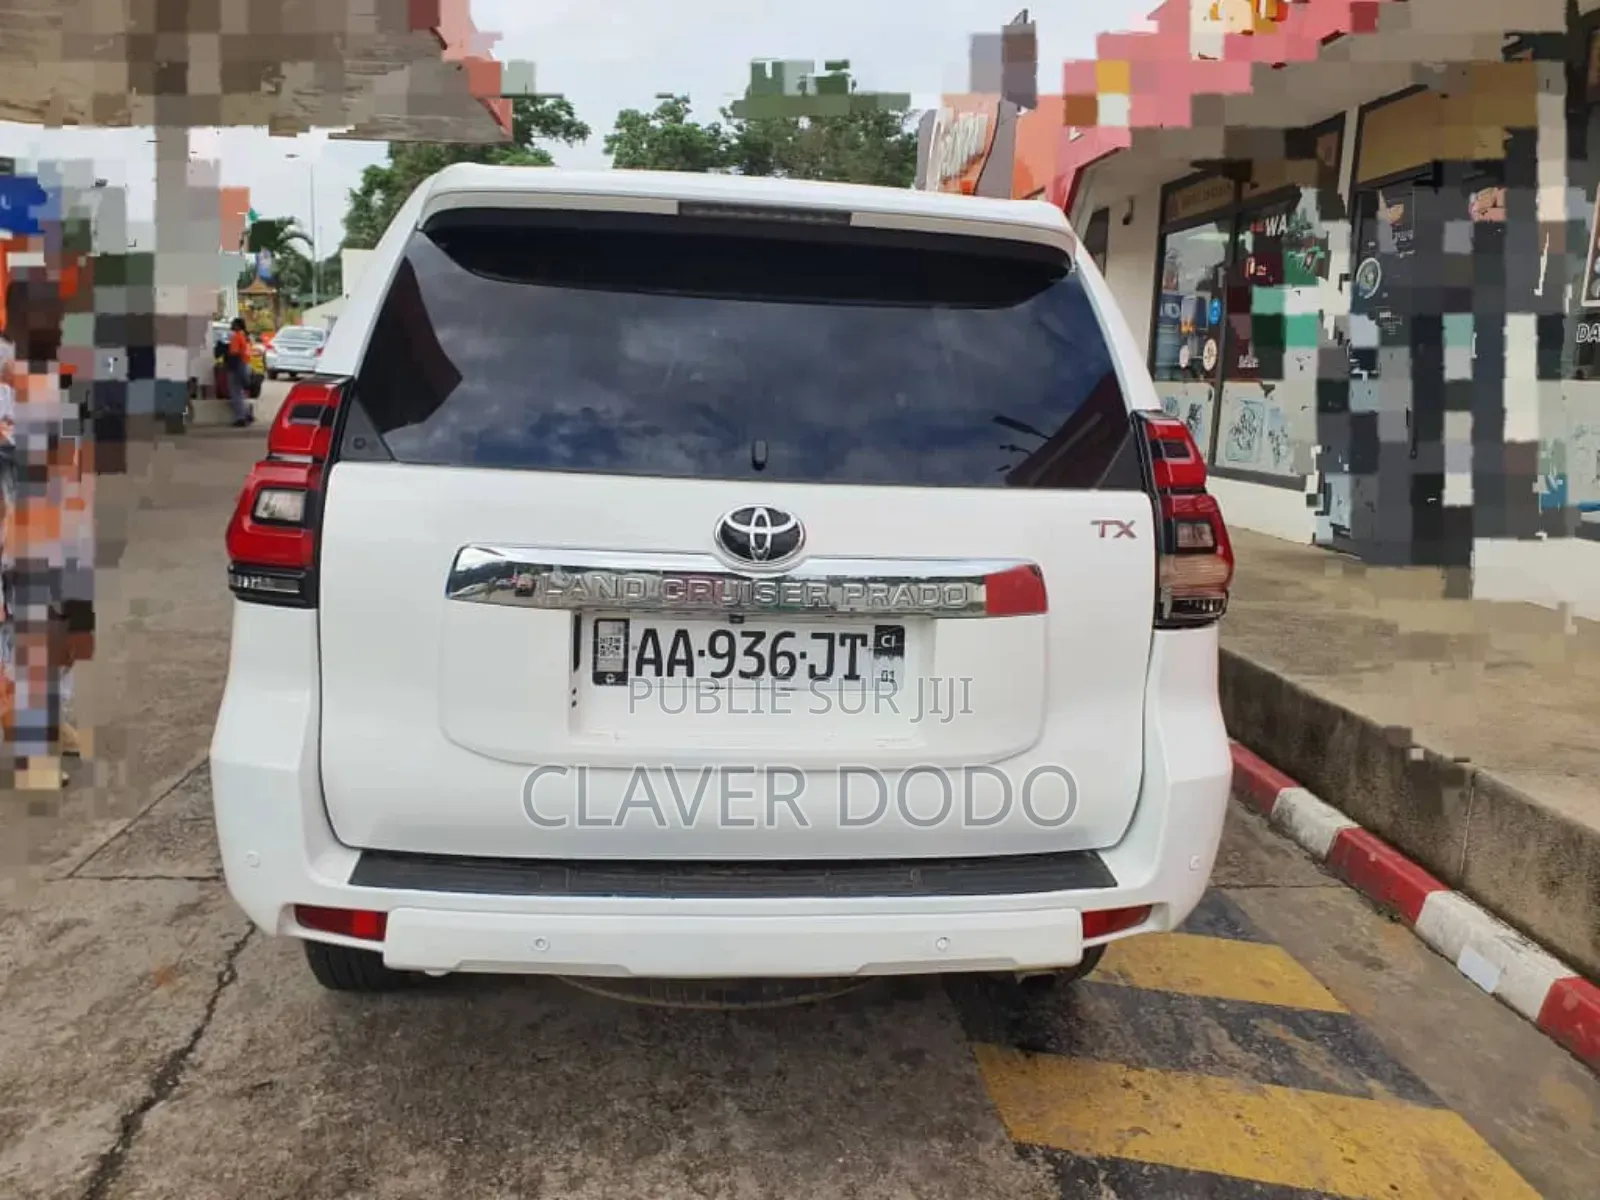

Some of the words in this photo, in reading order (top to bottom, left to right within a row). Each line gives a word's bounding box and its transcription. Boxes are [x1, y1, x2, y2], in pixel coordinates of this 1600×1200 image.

[1090, 519, 1137, 539] TX
[538, 572, 650, 602] LAND
[661, 574, 831, 609] CRUISER
[842, 581, 969, 609] PRADO
